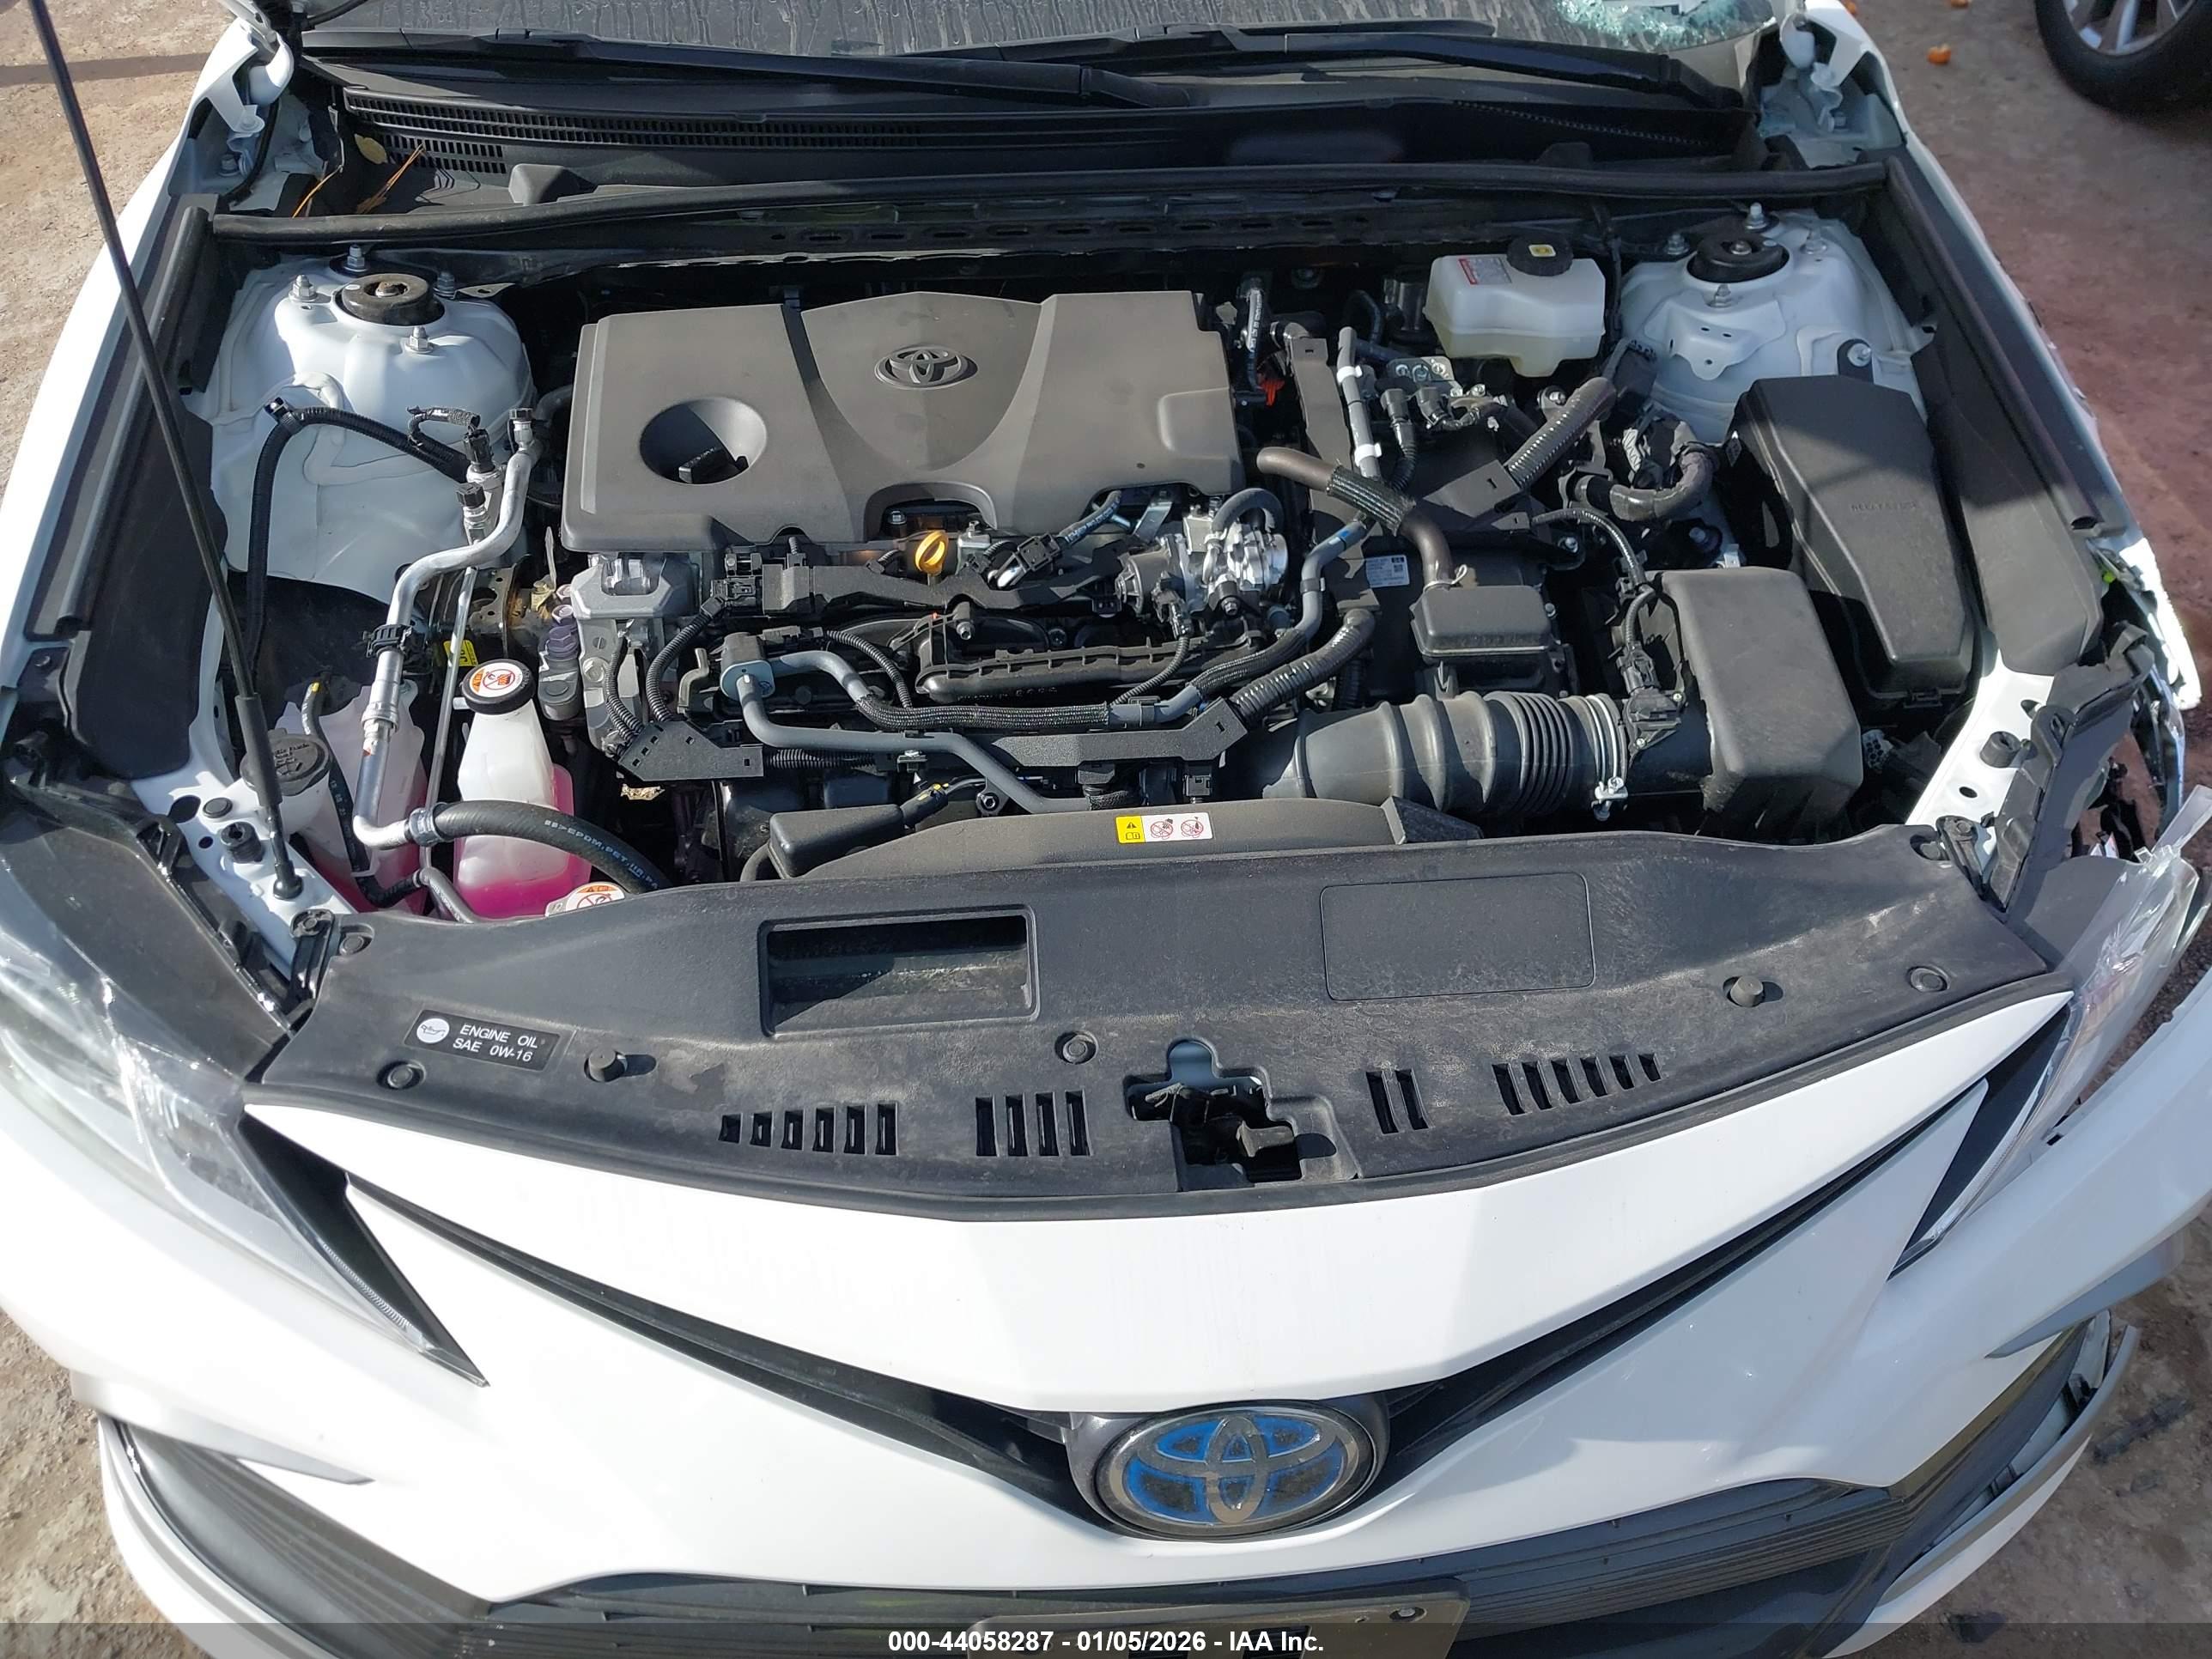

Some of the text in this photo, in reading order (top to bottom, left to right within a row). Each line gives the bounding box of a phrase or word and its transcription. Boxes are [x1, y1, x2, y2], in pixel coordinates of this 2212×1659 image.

[459, 1024, 538, 1048] ENGINE OIL
[453, 1038, 533, 1062] SAE 0W-16
